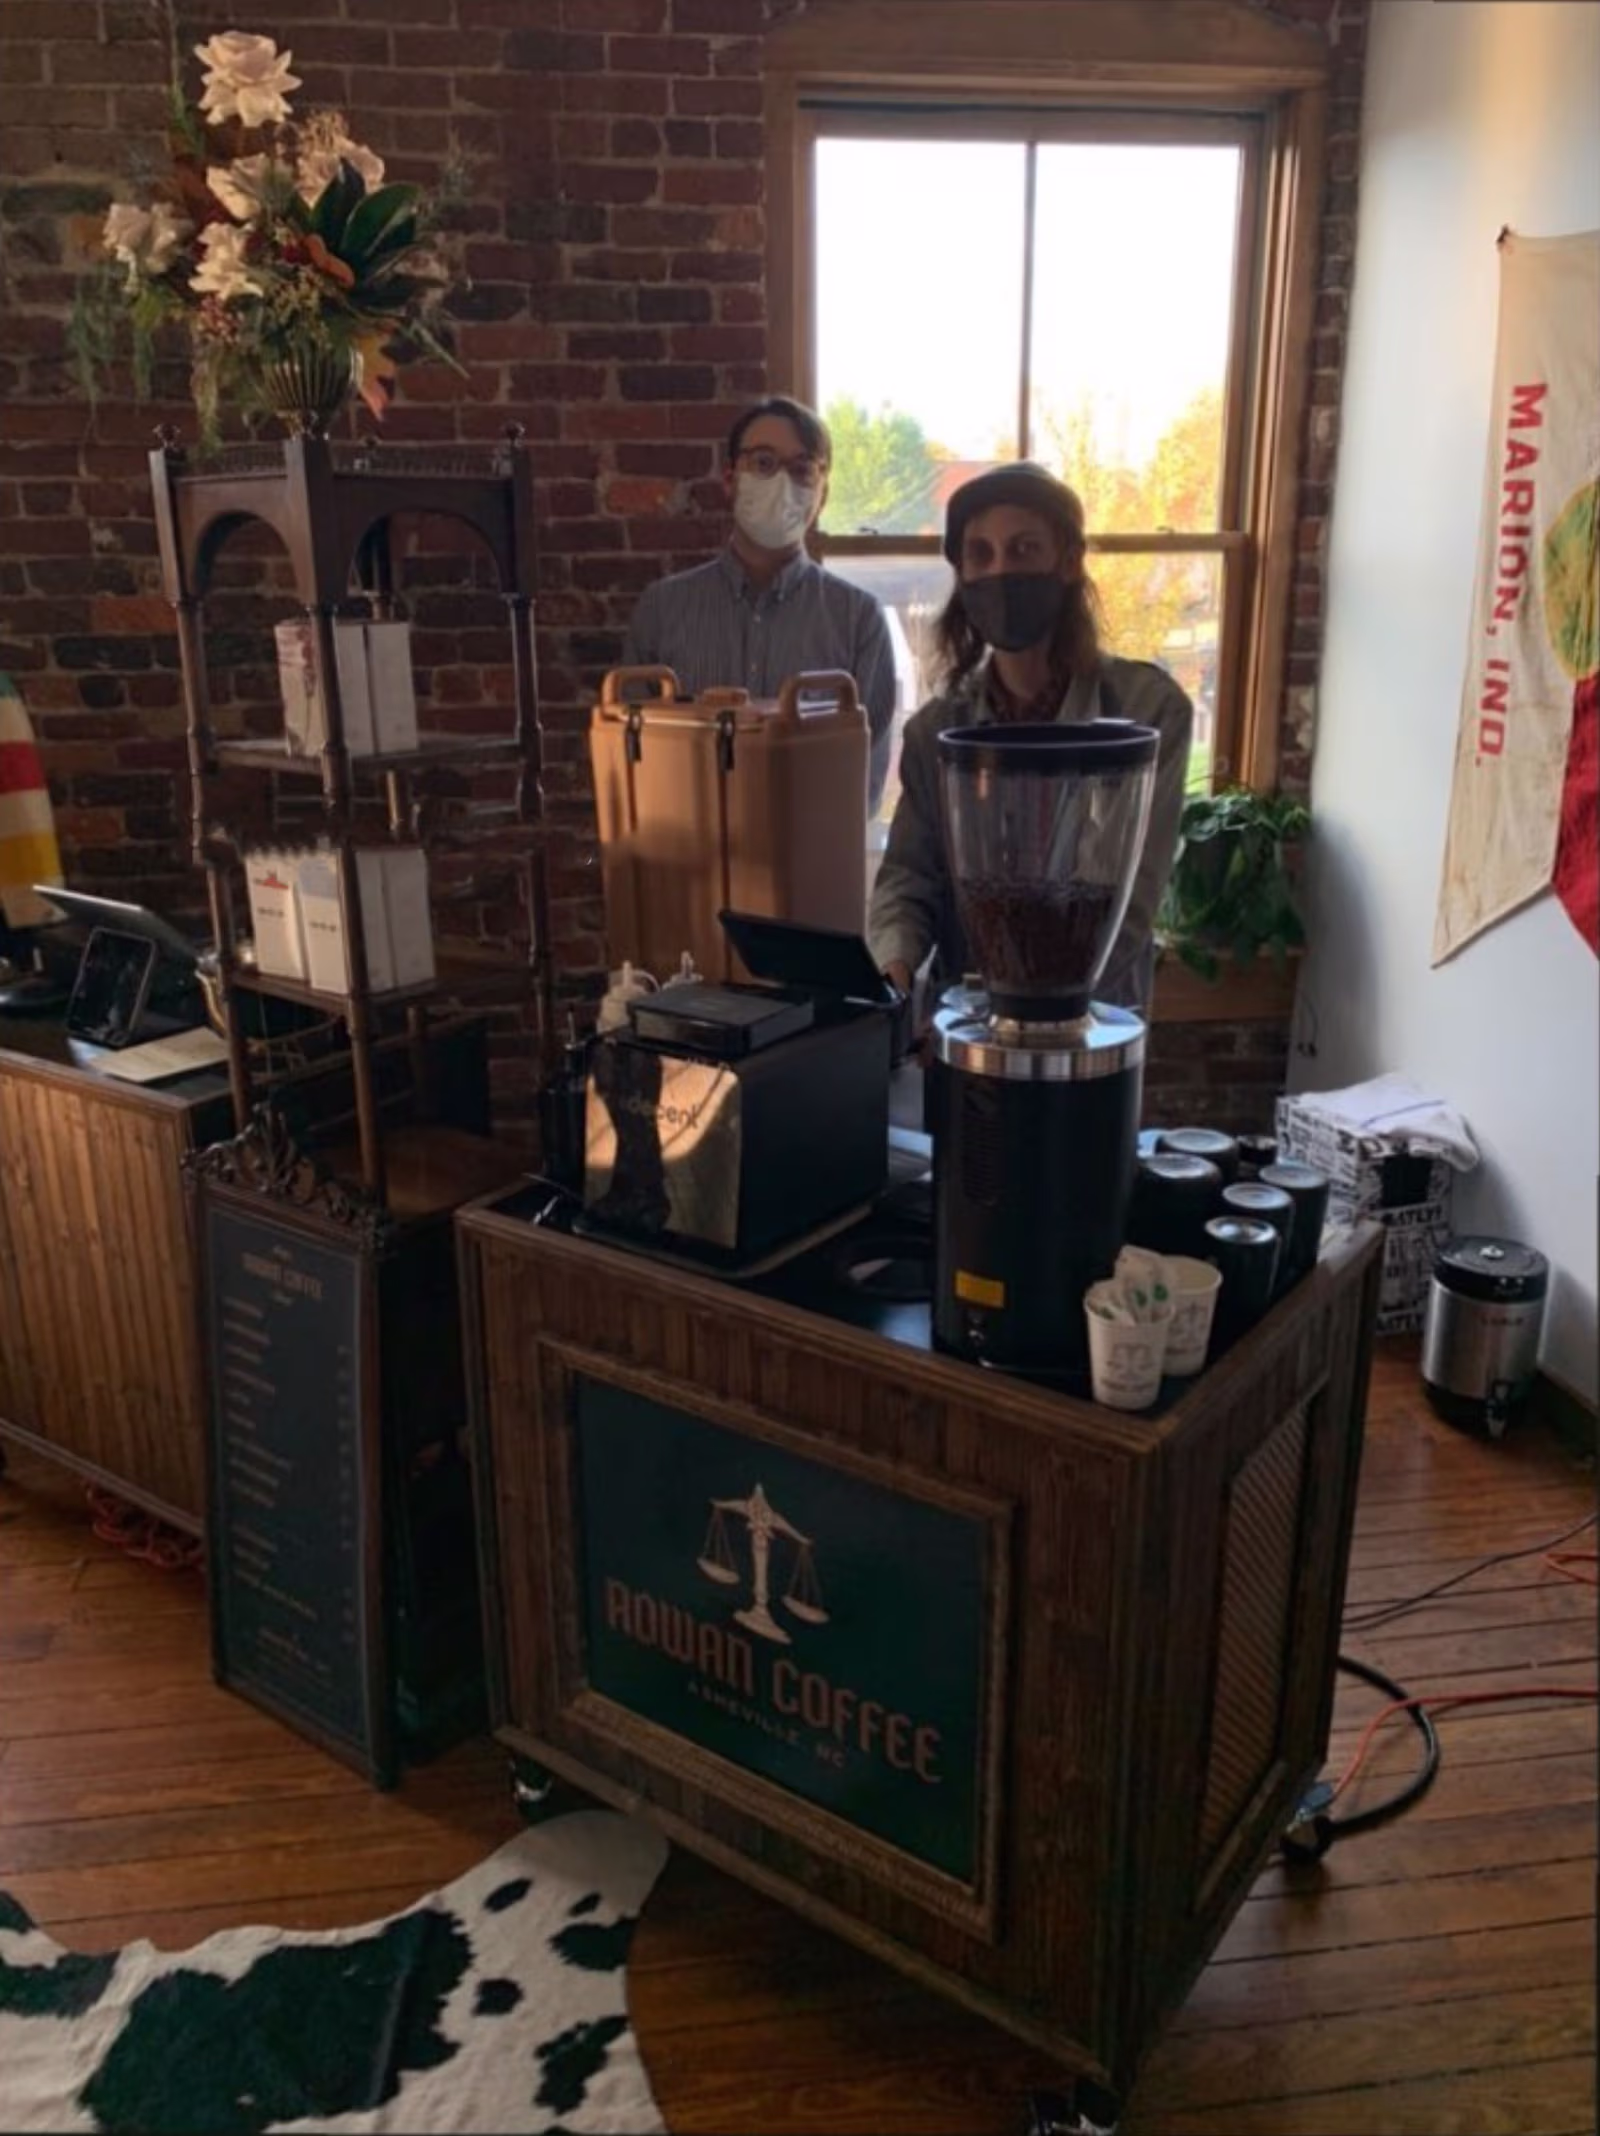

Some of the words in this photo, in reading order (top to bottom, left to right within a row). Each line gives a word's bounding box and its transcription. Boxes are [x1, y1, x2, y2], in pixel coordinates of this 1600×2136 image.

[1486, 382, 1549, 636] MARION,
[1475, 658, 1511, 767] IND.
[606, 1577, 754, 1697] ROWAN
[772, 1659, 942, 1783] COFFEE
